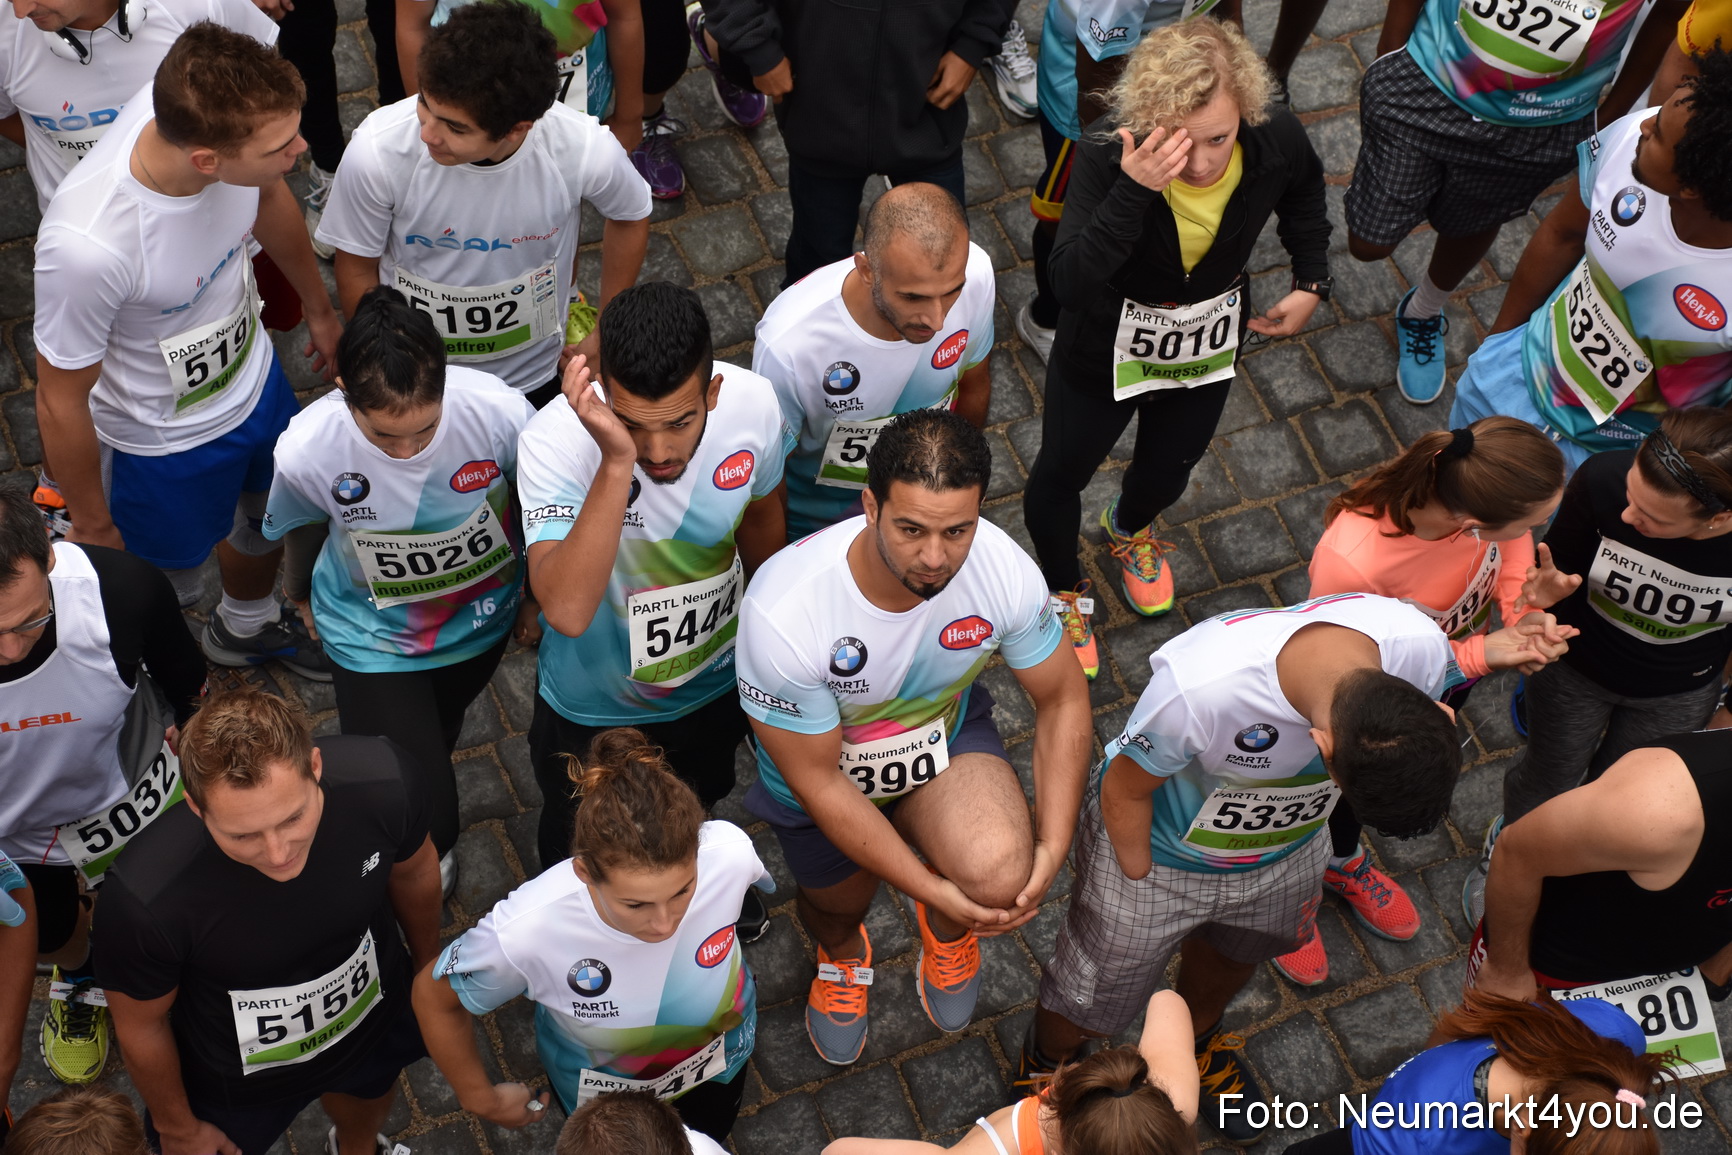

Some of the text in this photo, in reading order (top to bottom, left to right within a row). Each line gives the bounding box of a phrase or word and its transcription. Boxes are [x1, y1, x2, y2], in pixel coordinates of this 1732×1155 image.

[58, 140, 98, 151] PART
[1627, 187, 1647, 213] BMW
[1591, 217, 1613, 252] Neumarkt
[1595, 209, 1618, 246] PARTL
[398, 276, 506, 303] PARTL Neumarkt
[1125, 303, 1223, 328] PARTL Neumarkt
[1582, 260, 1632, 359] PARTL Neumarkt
[1680, 288, 1720, 326] Hervis
[446, 341, 496, 354] effrey
[1129, 314, 1231, 360] 5010
[1569, 281, 1630, 389] 5328
[169, 338, 213, 363] PARTL
[185, 316, 252, 388] 519
[825, 362, 856, 377] BMW
[1142, 364, 1209, 378] Vanessa
[333, 473, 366, 487] BMW
[457, 466, 496, 487] Hervis
[719, 459, 751, 483] Hervis
[341, 507, 376, 518] ARTL
[357, 525, 475, 550] PARTL Neumarkt
[375, 528, 493, 578] 5026
[1601, 548, 1721, 595] PARTL Neumarkt
[632, 574, 736, 616] PARTL Neumarkt
[1440, 568, 1496, 635] 092
[1604, 570, 1724, 625] 5091
[646, 580, 738, 658] 5444
[947, 624, 988, 643] Hervis
[831, 638, 863, 655] BMW
[739, 677, 801, 715] BOCK
[0, 712, 82, 734] LEBL
[1241, 724, 1276, 735] BMW
[858, 740, 923, 762] Neumarkt
[1225, 758, 1271, 769] Neumarkt
[1227, 754, 1272, 764] PARTL
[839, 752, 936, 795] 399
[77, 752, 176, 854] 5032
[1213, 785, 1330, 802] PARTL Neumarkt
[1212, 793, 1332, 831] 5333
[570, 960, 605, 975] BMW
[237, 958, 360, 1011] PARTL Neumarkt
[1604, 973, 1674, 998] Neumarkt
[257, 960, 370, 1045] 5158
[572, 1001, 618, 1012] PARTL
[574, 1010, 620, 1019] Neumarkt
[300, 1020, 344, 1054] Marc
